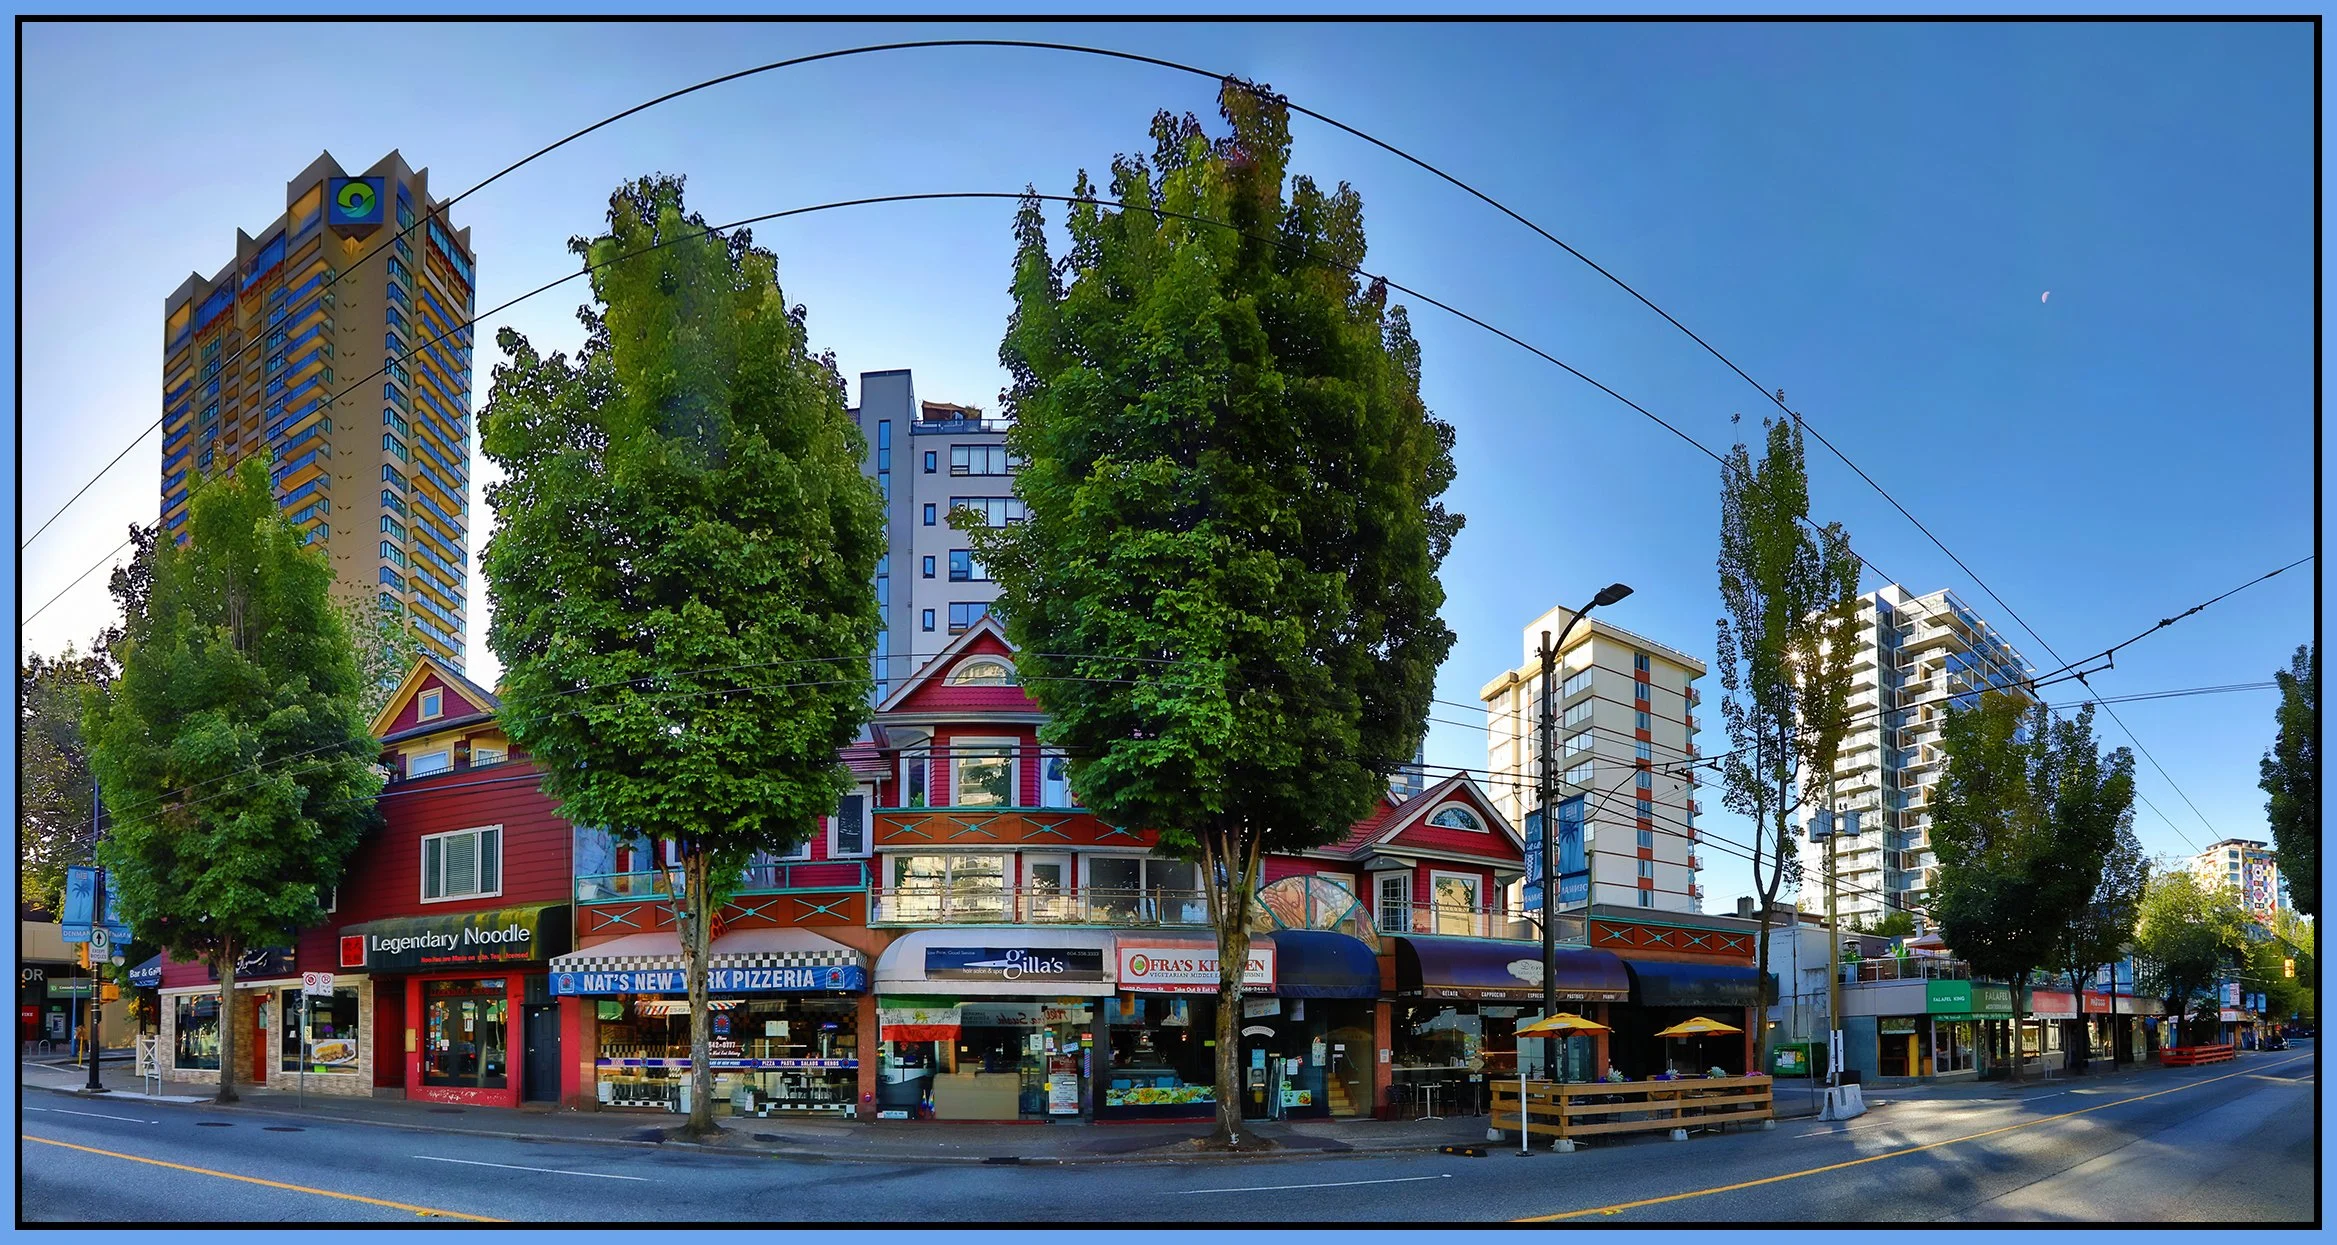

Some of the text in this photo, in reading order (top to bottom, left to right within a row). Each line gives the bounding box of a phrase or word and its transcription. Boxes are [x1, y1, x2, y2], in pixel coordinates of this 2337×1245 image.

[372, 930, 459, 954] Legendary
[464, 924, 530, 945] Noodle
[129, 969, 140, 978] Bar
[141, 968, 147, 976] &
[1003, 949, 1064, 980] gilla's
[1129, 954, 1265, 977] OFRA'S KITEN
[583, 969, 815, 991] NAT'S NEW YRK PIZZERIA
[1985, 991, 2008, 1000] FALAFEL
